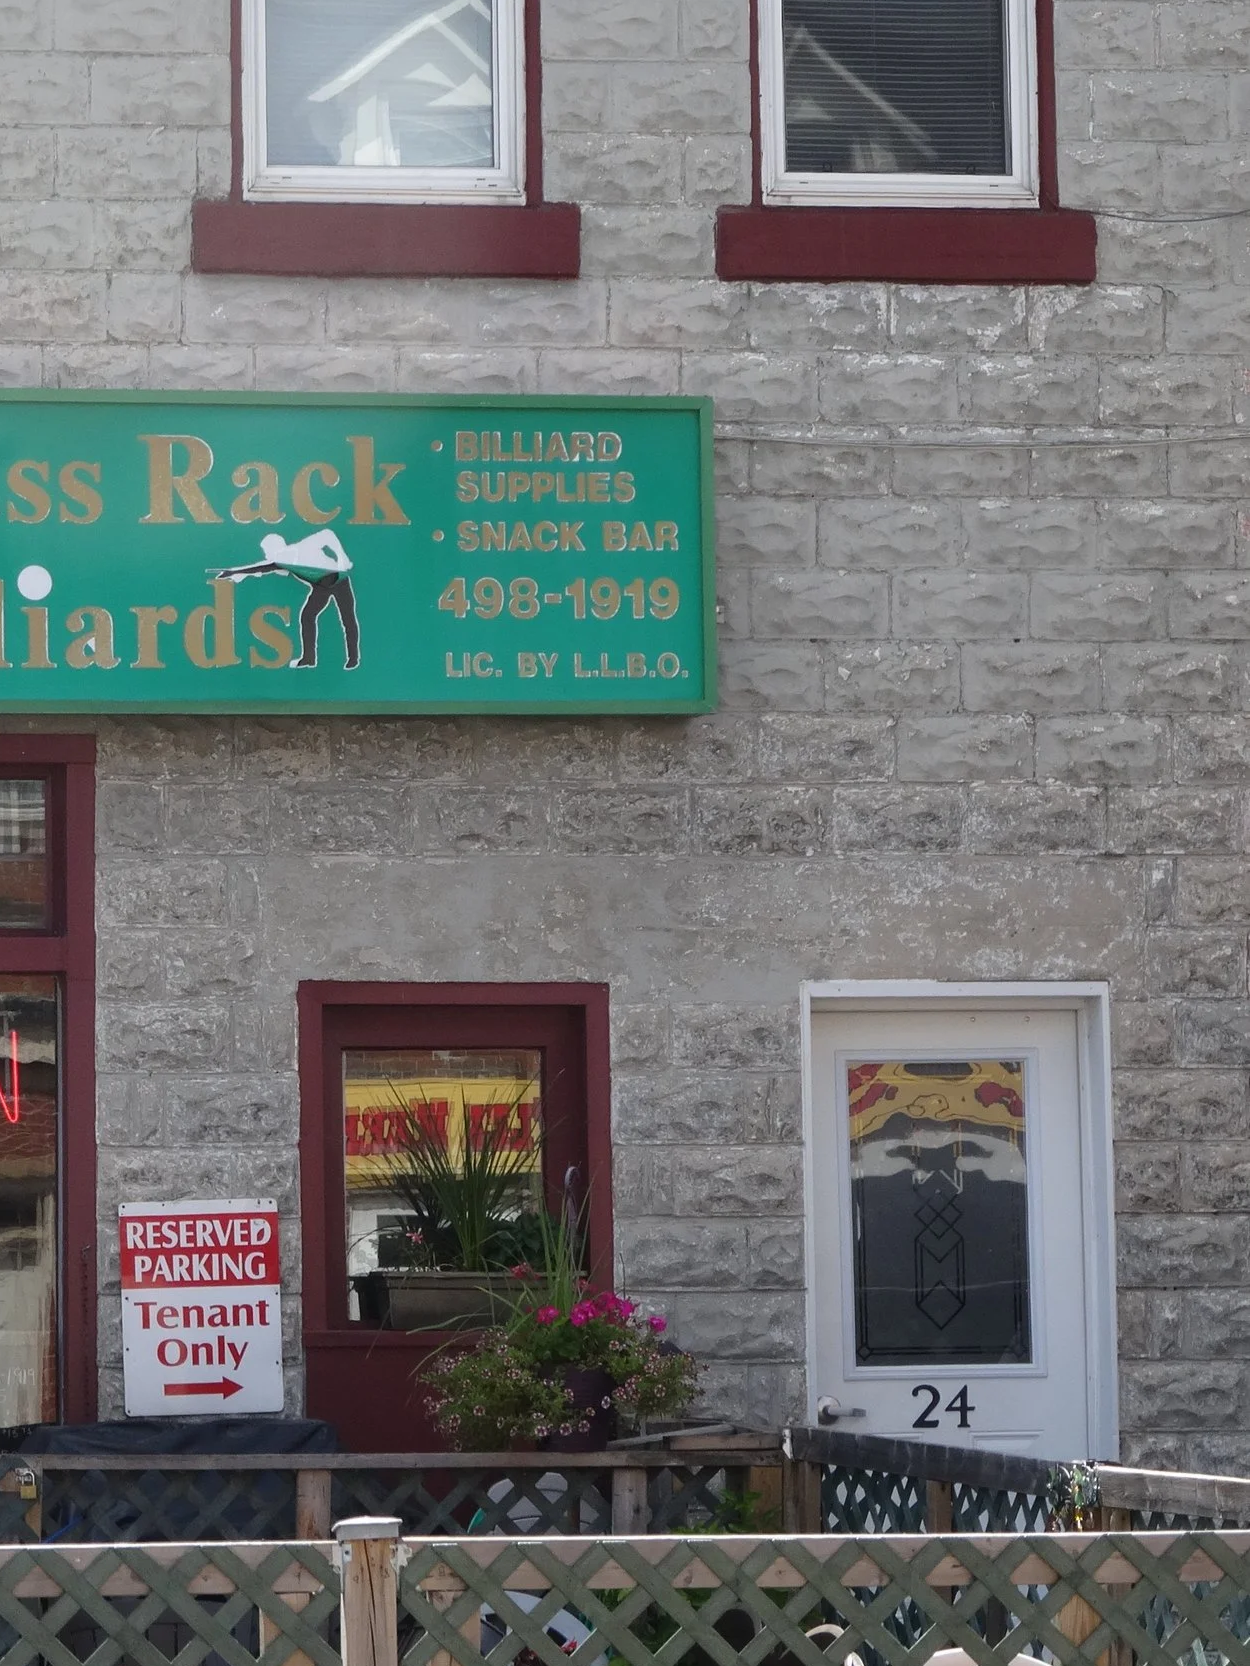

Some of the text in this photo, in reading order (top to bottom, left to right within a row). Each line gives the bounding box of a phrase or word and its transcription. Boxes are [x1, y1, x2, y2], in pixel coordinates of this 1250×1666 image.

[455, 431, 622, 462] BILLIARD
[137, 433, 412, 526] Rack
[456, 471, 636, 503] SUPPLIES
[457, 520, 679, 551] SNACK BAR
[438, 577, 680, 619] 498-1919
[445, 652, 689, 678] LIC. BY L.L.B.O.
[126, 1218, 272, 1250] RESERVED
[134, 1252, 267, 1283] PARKING
[134, 1300, 270, 1330] Tenant
[156, 1335, 249, 1371] Only
[911, 1383, 977, 1429] 24
